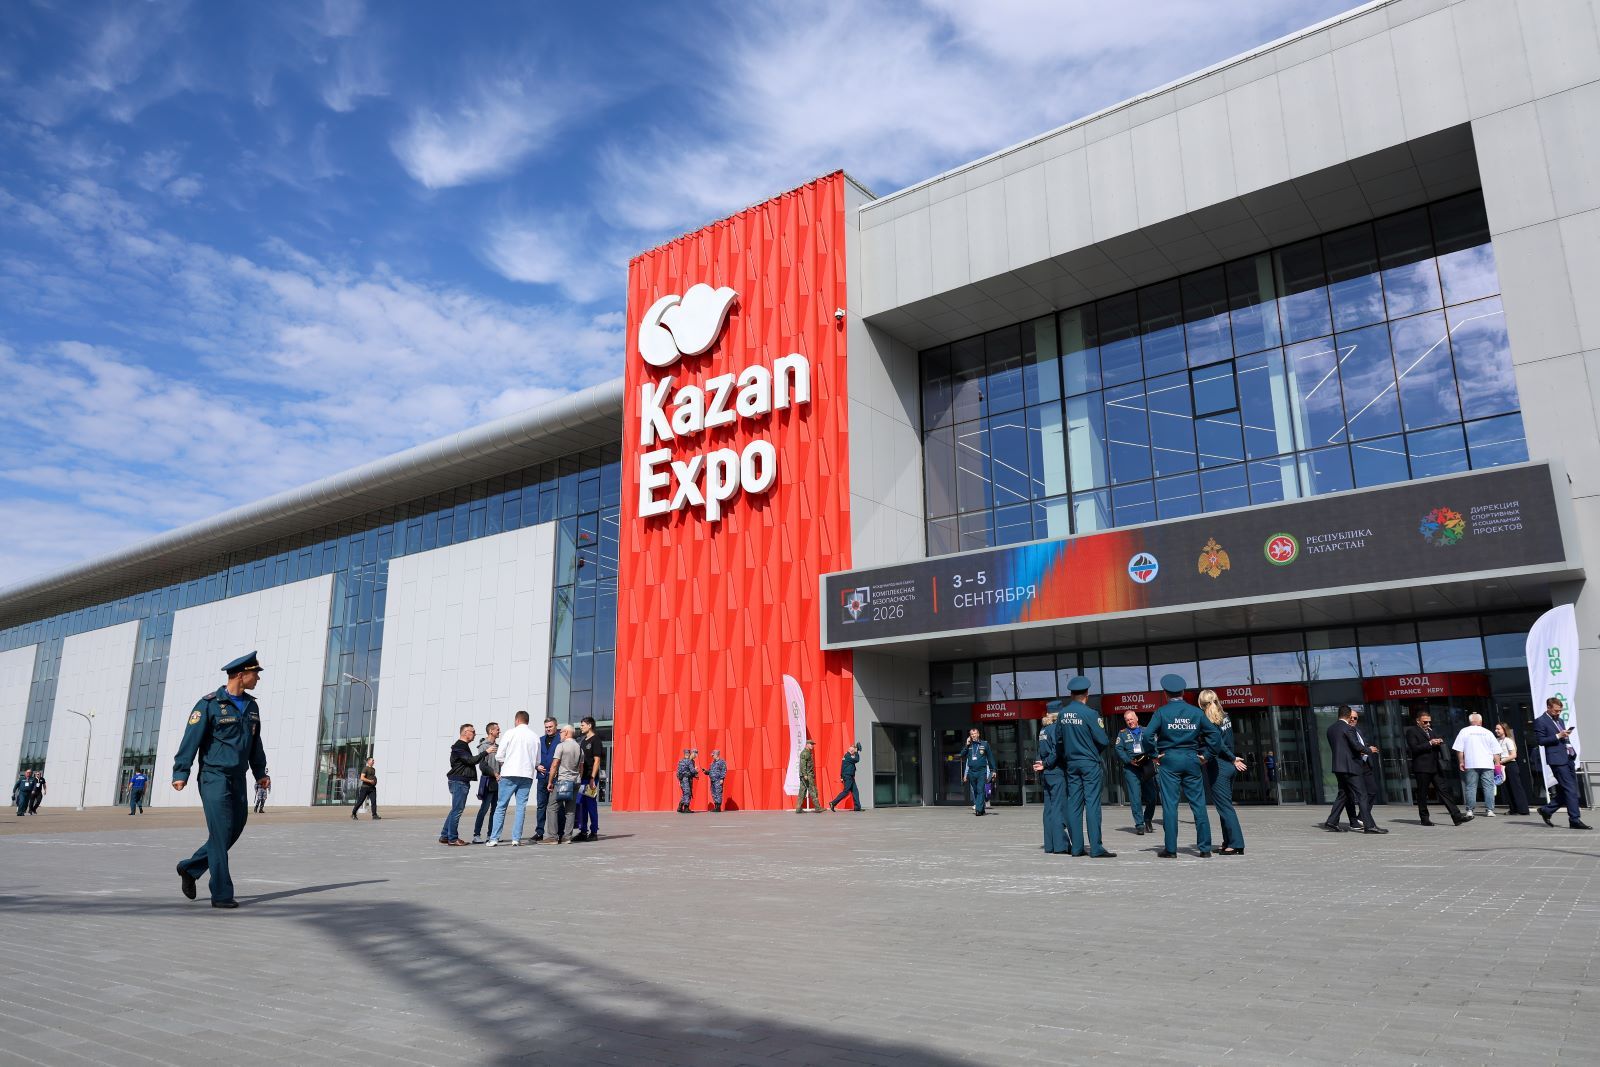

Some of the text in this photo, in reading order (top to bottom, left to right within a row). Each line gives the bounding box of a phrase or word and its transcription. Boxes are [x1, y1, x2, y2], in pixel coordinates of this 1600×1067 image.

[640, 352, 810, 446] Kazan
[638, 439, 776, 522] Expo
[1470, 500, 1520, 514] ДИРЕКЦИЯ
[1471, 509, 1520, 521] СПОРТИВНЫХ
[1473, 522, 1523, 535] ПРОЕКТОВ
[1305, 528, 1373, 545] РЕСПУБЛИКА
[1306, 539, 1365, 554] ТАТАРСТАН
[872, 586, 915, 598] КОМПЛЕКСНАЯ
[953, 584, 1036, 608] СЕНТЯБРЯ
[872, 594, 916, 606] БЕЗОПАСНОСТЬ
[873, 604, 904, 621] 2026
[1547, 646, 1563, 677] 185
[1399, 676, 1430, 687] ВХОД
[1121, 694, 1145, 703] ВХОД
[1226, 687, 1253, 697] ВХОД
[1389, 688, 1422, 696] ENTRANCE
[986, 703, 1007, 711] ВХОД
